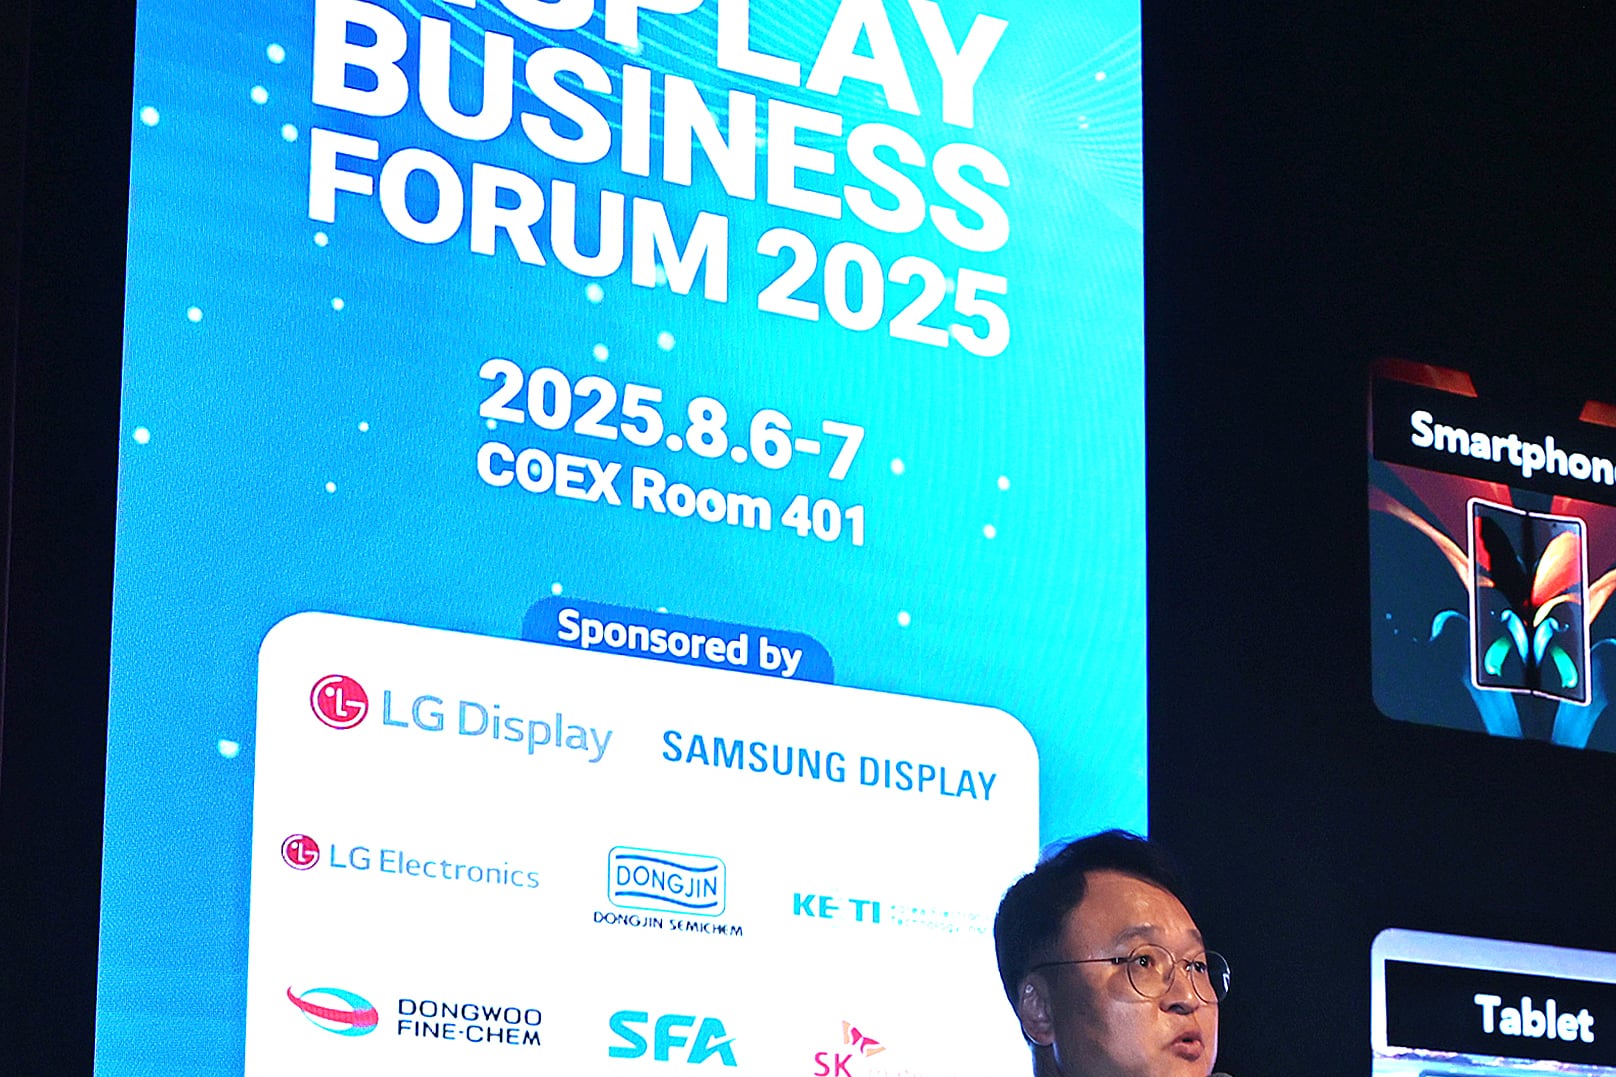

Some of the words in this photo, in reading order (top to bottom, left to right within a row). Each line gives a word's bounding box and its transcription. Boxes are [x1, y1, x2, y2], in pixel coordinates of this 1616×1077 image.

[310, 0, 1010, 252] BUSINESS
[308, 127, 729, 304] FORUM
[756, 227, 1010, 357] 2025
[477, 357, 864, 481] 2025.8.6-7
[475, 442, 621, 507] COEX
[632, 464, 772, 531] Room
[780, 494, 864, 546] 401
[557, 609, 748, 669] Sponsored
[758, 633, 802, 678] by
[383, 690, 444, 731] LG
[457, 700, 614, 762] Display
[661, 729, 845, 784] SAMSUNG
[859, 755, 997, 801] DISPLAY
[330, 844, 371, 871] LG
[380, 848, 541, 889] Electronics
[617, 866, 717, 898] DONGJIN
[594, 911, 663, 930] DONGJIN
[669, 919, 743, 936] SEMICHEM
[396, 1019, 542, 1047] FINE-CHEM
[397, 998, 542, 1027] DONGWOO
[608, 1009, 738, 1067] SFA
[1474, 992, 1595, 1045] Tablet
